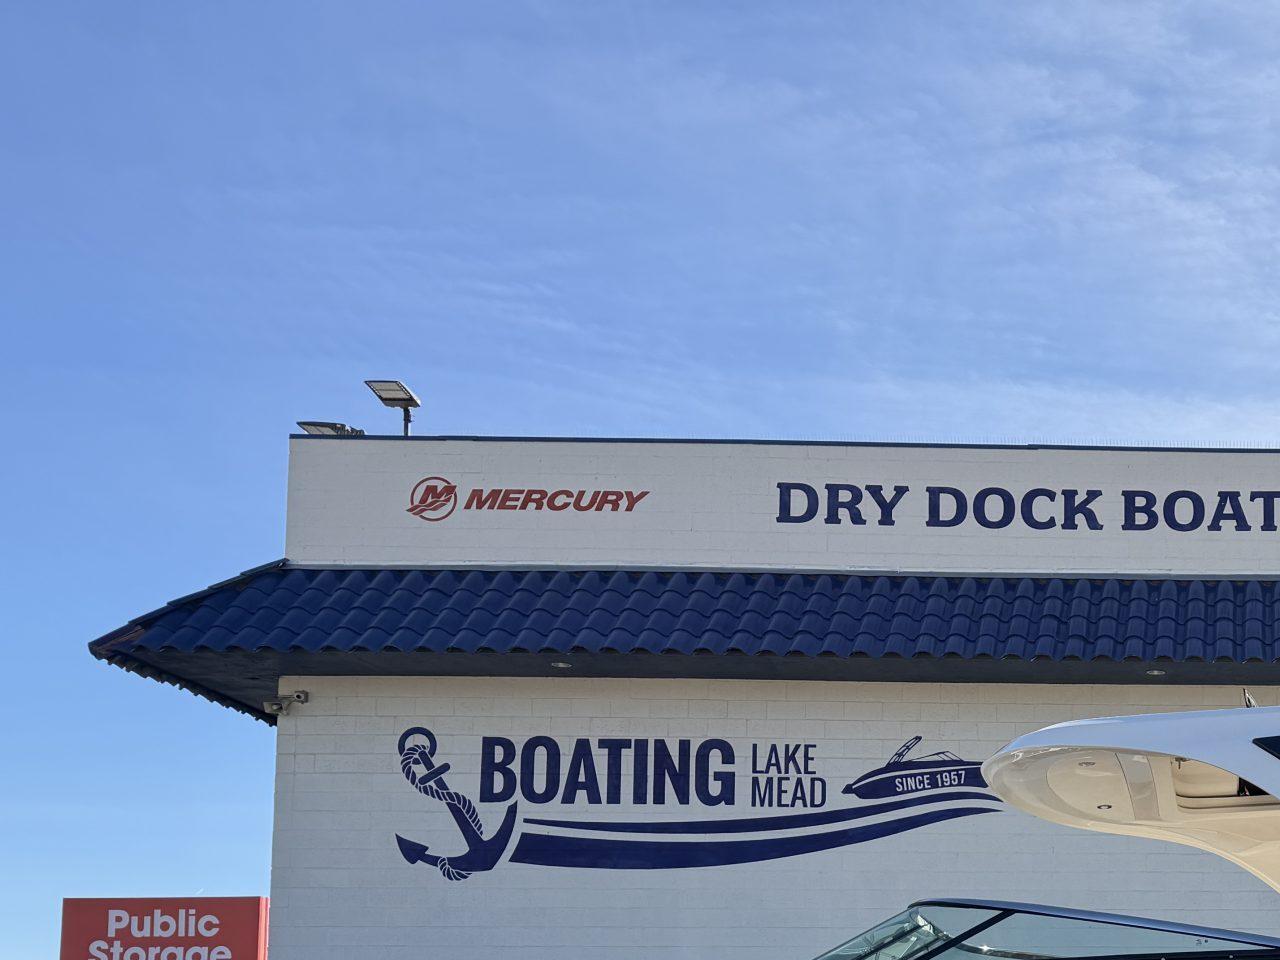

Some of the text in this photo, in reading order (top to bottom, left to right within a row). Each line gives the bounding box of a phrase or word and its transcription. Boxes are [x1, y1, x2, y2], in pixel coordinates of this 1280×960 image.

[463, 488, 650, 512] MERCURY
[776, 482, 909, 526] DRY
[926, 487, 1104, 531] DOCK
[480, 736, 735, 806] BOATING
[751, 743, 817, 775] LAKE
[751, 777, 827, 808] MEAD
[895, 770, 965, 792] SINCE 1957
[107, 909, 220, 938] Public
